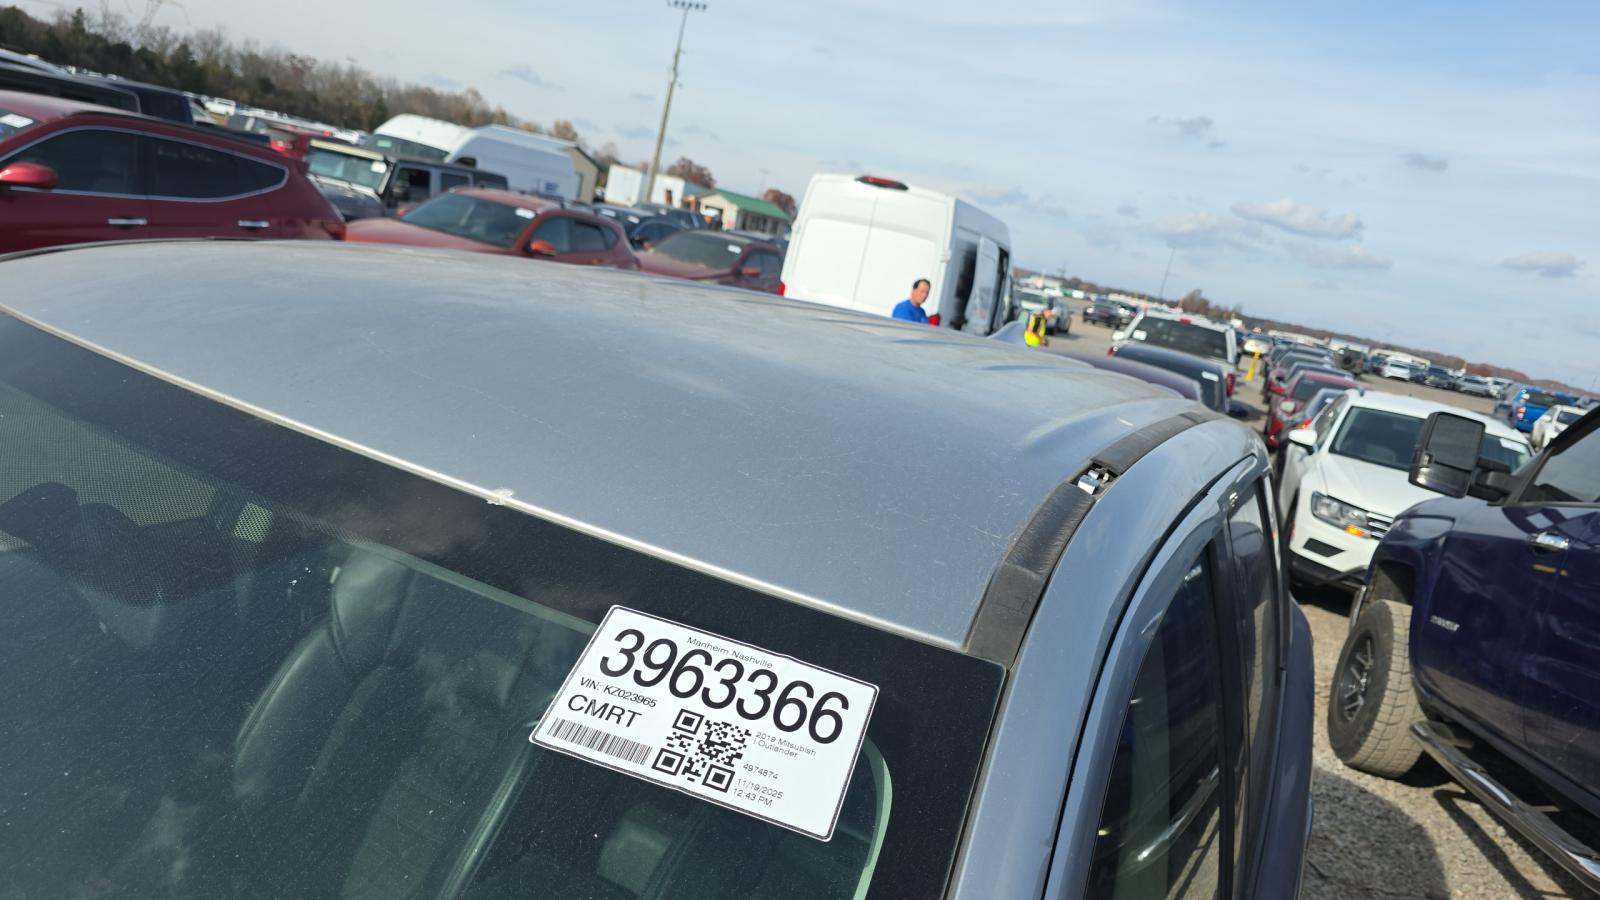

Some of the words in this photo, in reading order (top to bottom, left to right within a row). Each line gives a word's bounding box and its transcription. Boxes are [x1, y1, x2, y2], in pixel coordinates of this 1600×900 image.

[686, 636, 729, 656] Manheim
[731, 649, 773, 669] Nashville
[600, 629, 849, 744] 3963366
[603, 685, 658, 708] KZ023965
[567, 694, 642, 728] CMRT
[755, 731, 776, 743] 2019
[758, 740, 798, 758] Outlander
[742, 763, 779, 780] 4974874
[737, 778, 783, 799] 11/19/2025
[758, 795, 773, 807] PM
